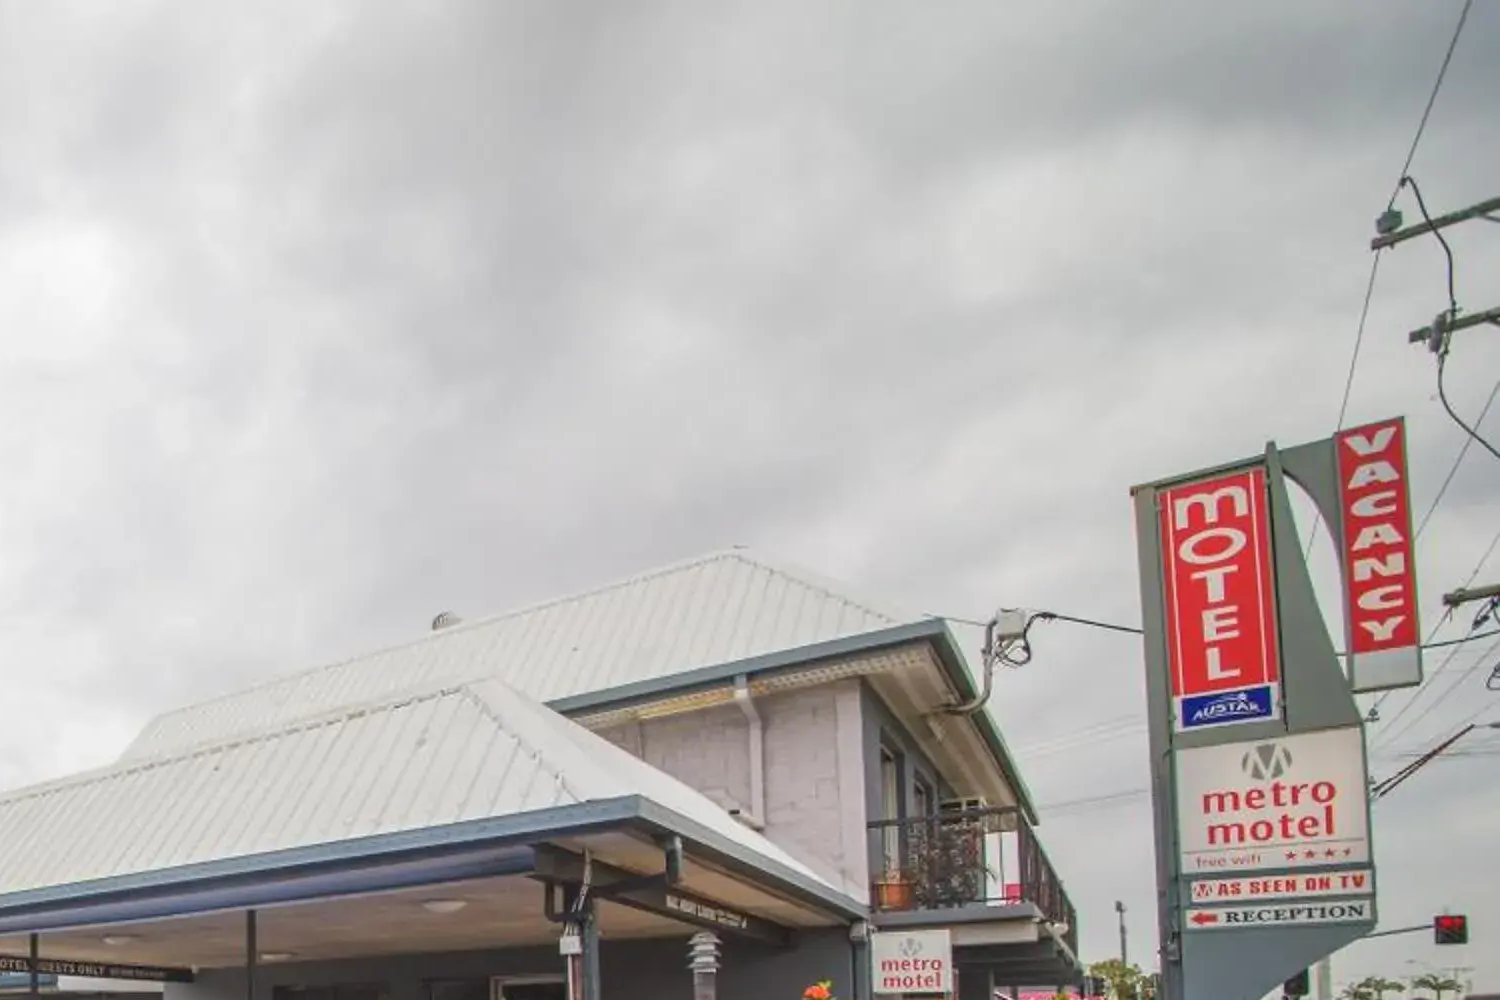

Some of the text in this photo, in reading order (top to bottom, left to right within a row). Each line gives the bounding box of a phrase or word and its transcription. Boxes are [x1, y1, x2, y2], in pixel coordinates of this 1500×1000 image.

[1344, 427, 1406, 641] VACANCY
[1175, 485, 1249, 680] MOTEL
[1203, 781, 1336, 815] metro
[1207, 805, 1335, 845] motel
[1197, 854, 1261, 869] free wifi
[1218, 882, 1241, 896] AS
[1250, 879, 1297, 894] SEEN
[1306, 876, 1331, 891] ON
[1341, 874, 1365, 889] TV
[1225, 905, 1364, 923] RECEPTION
[881, 957, 942, 971] metro
[883, 973, 942, 988] motel
